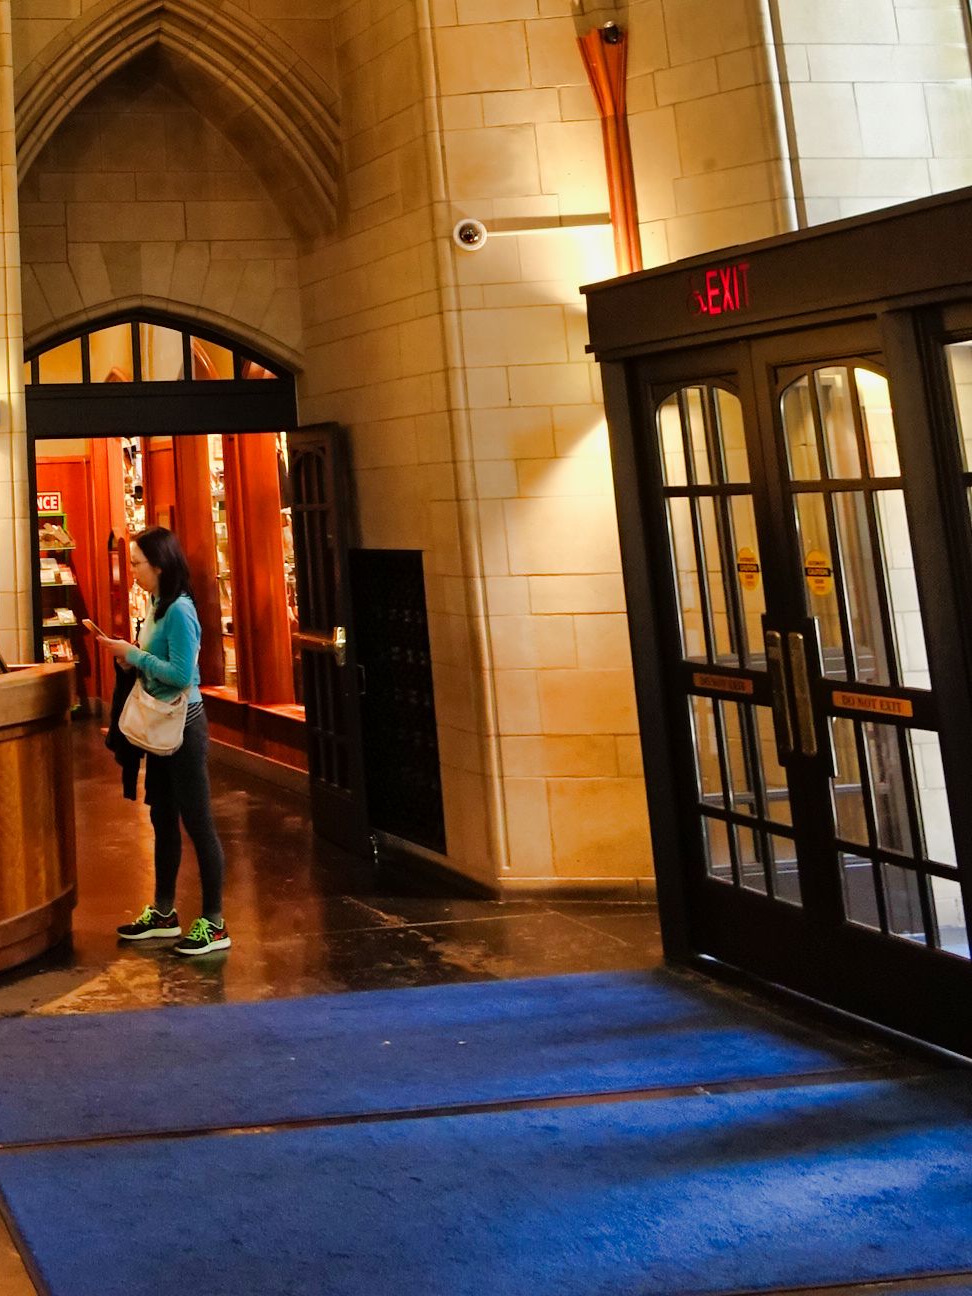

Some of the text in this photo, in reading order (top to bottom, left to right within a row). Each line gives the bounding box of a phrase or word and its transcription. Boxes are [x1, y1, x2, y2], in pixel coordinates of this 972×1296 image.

[705, 263, 749, 314] EXIT
[37, 495, 58, 510] NCE
[841, 694, 902, 714] DO NOT EXIT
